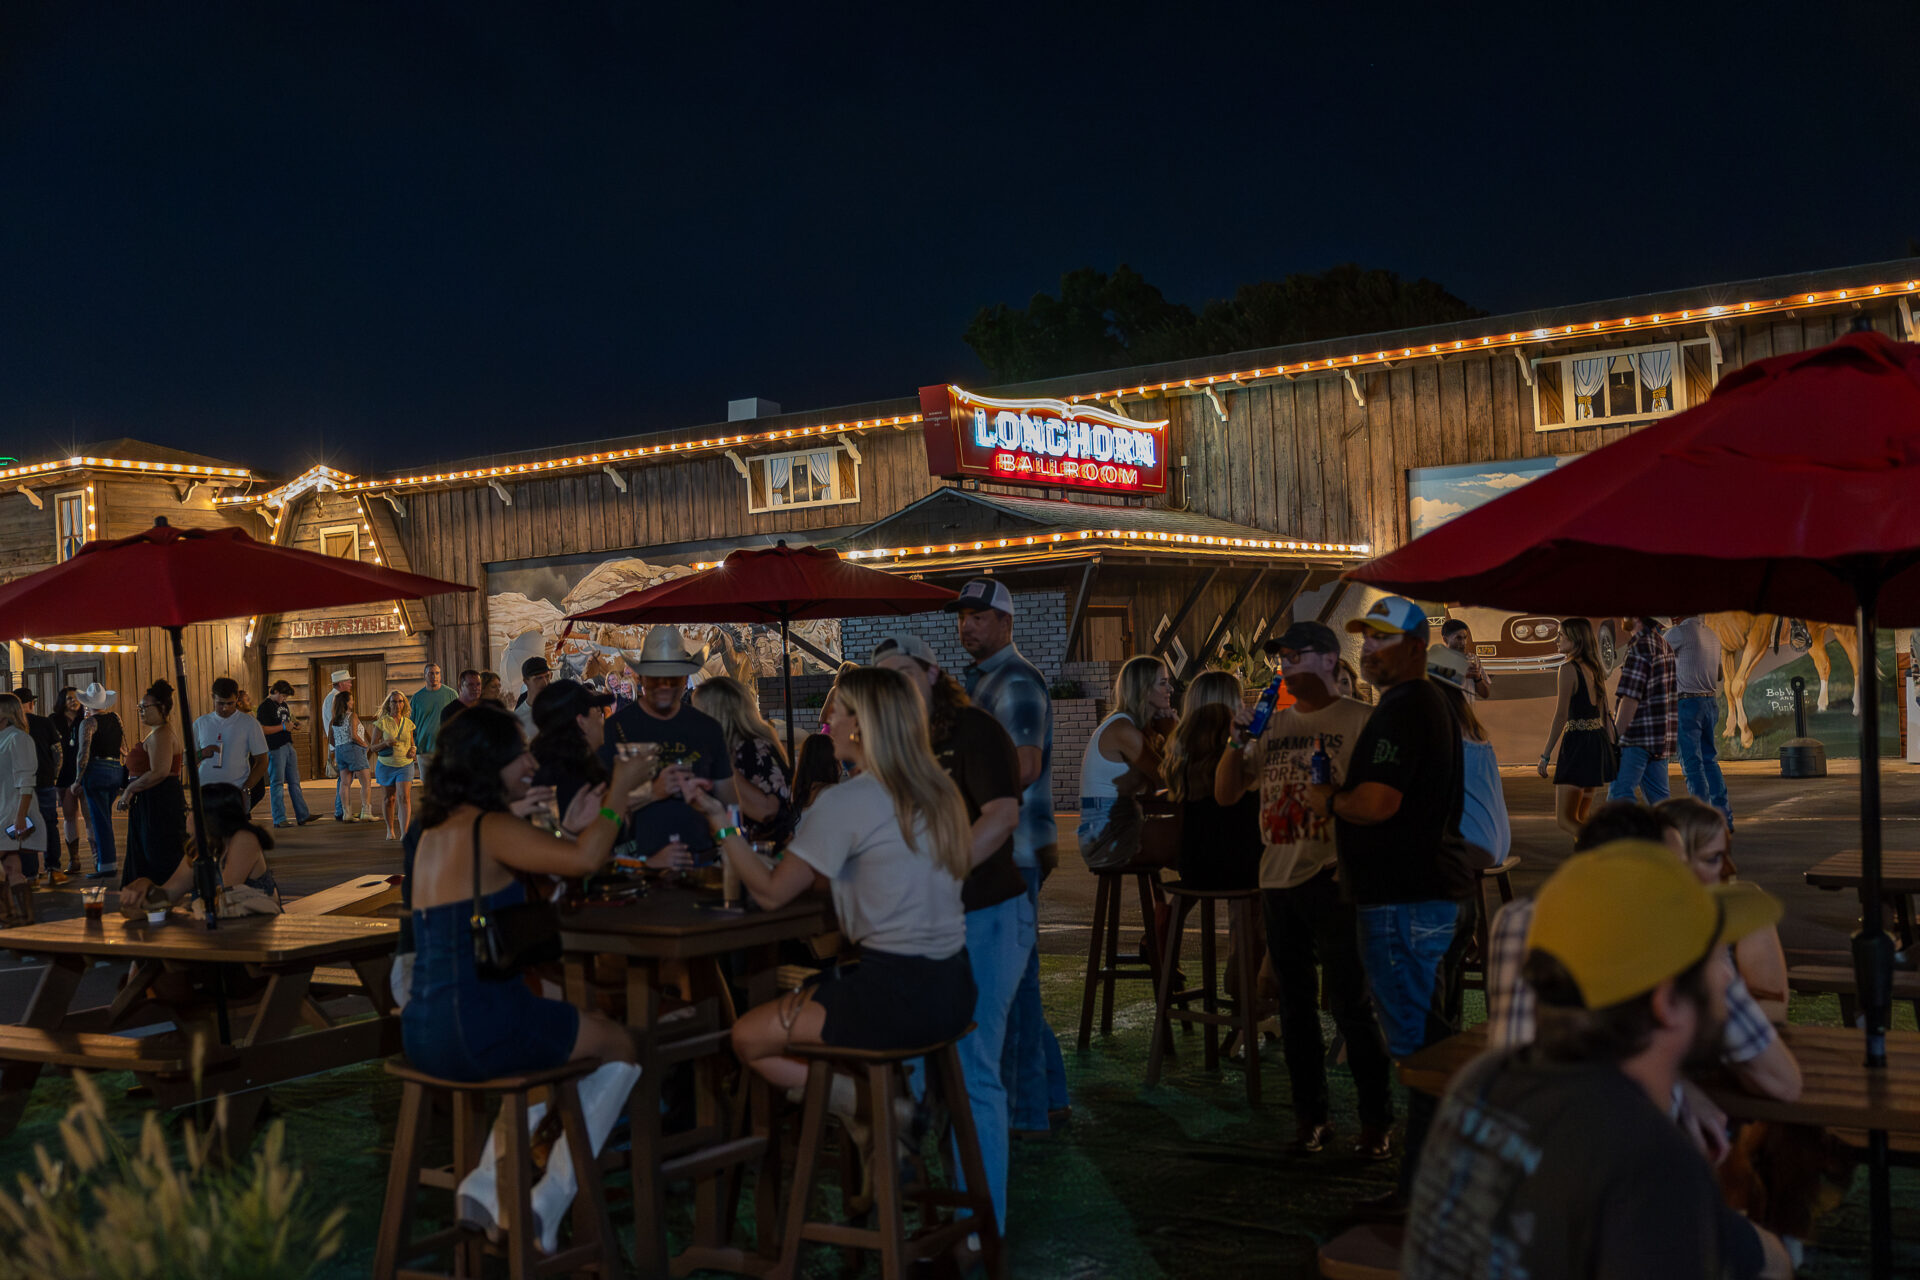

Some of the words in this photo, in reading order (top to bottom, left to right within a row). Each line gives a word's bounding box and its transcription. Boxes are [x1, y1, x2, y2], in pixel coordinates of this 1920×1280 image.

[974, 407, 1156, 467] LONGHORN
[996, 453, 1138, 485] BALLROOM
[1766, 688, 1784, 696] Bob
